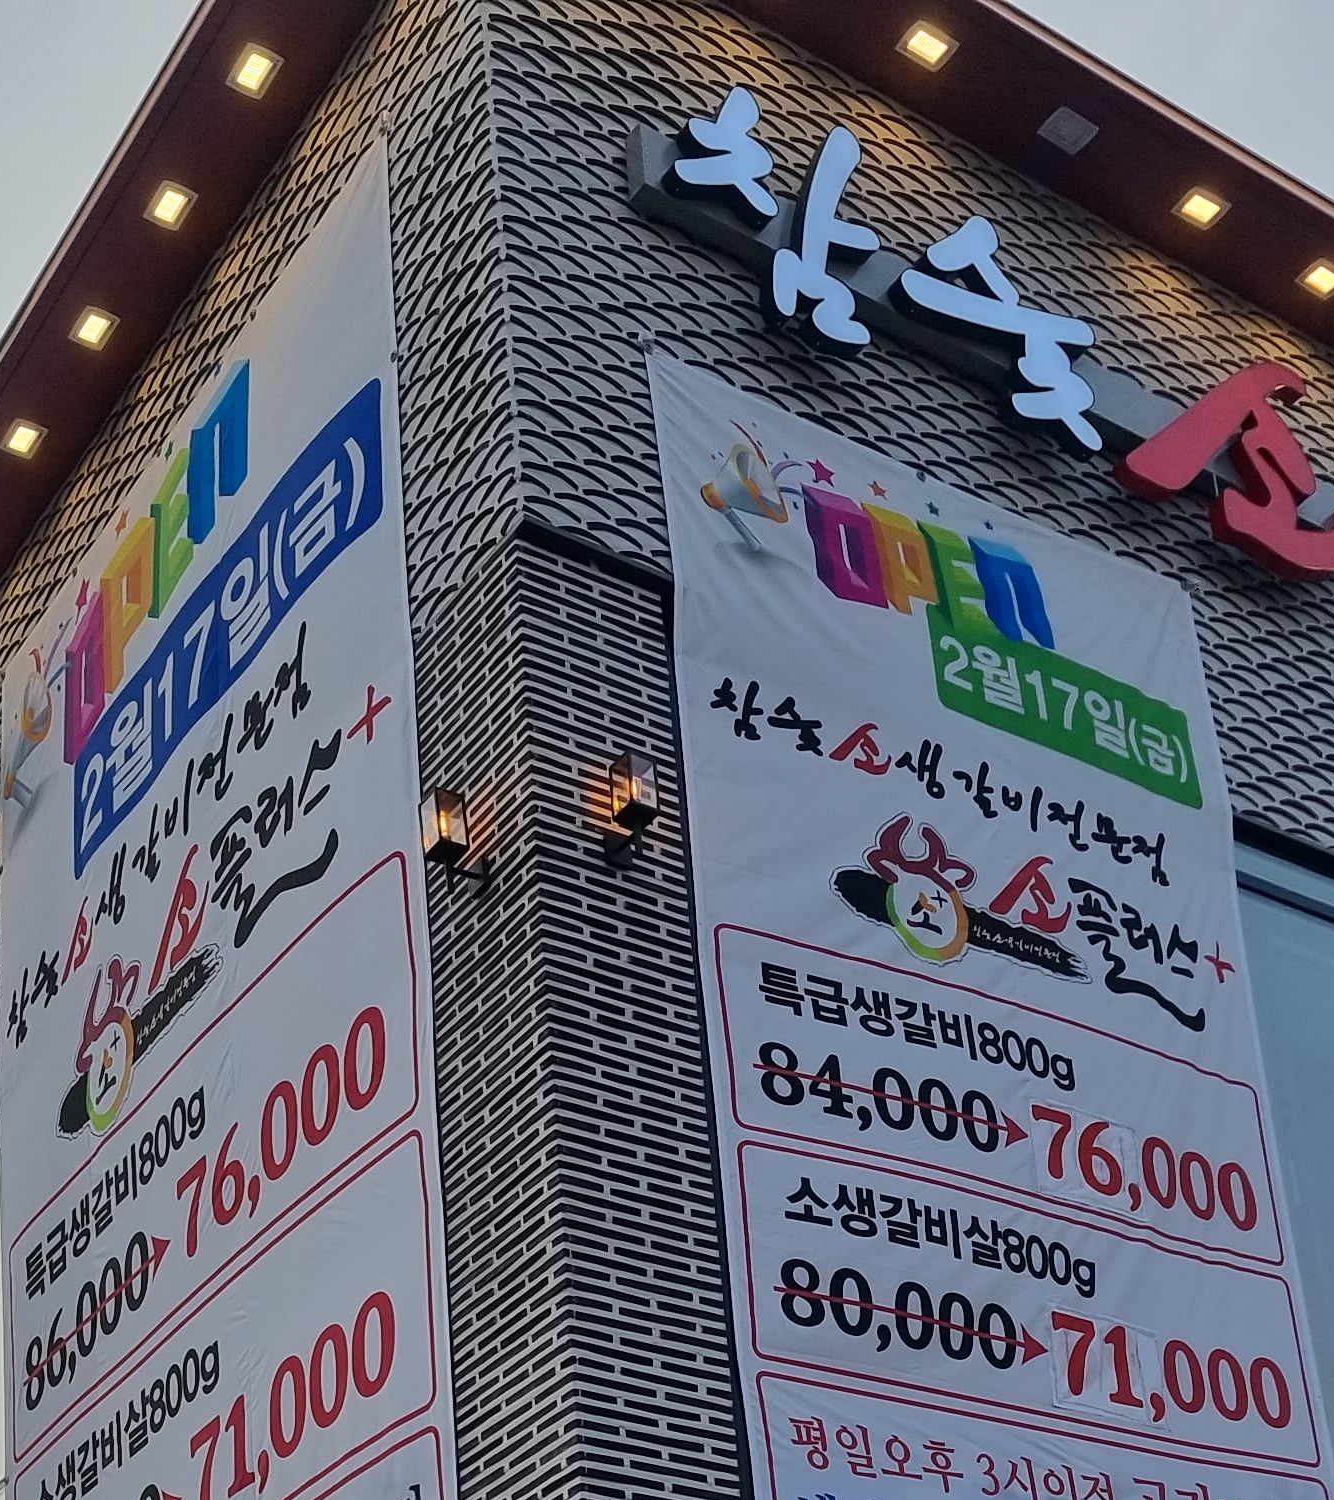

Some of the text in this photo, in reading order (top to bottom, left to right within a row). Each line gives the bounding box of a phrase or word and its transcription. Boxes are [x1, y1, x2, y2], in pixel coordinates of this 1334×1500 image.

[79, 437, 365, 854] 2월17일(금)
[939, 635, 1188, 784] 2월17일(금)
[758, 961, 1076, 1092] 특급생갈비800g
[24, 1083, 207, 1300] 특급생갈비800g
[176, 1006, 386, 1258] 76,000
[758, 1041, 1258, 1231] 84,000 76,000
[783, 1176, 1096, 1299] 소생갈비살800g
[778, 1258, 1292, 1430] 80,000 71,000
[790, 1415, 964, 1494] 평일오후
